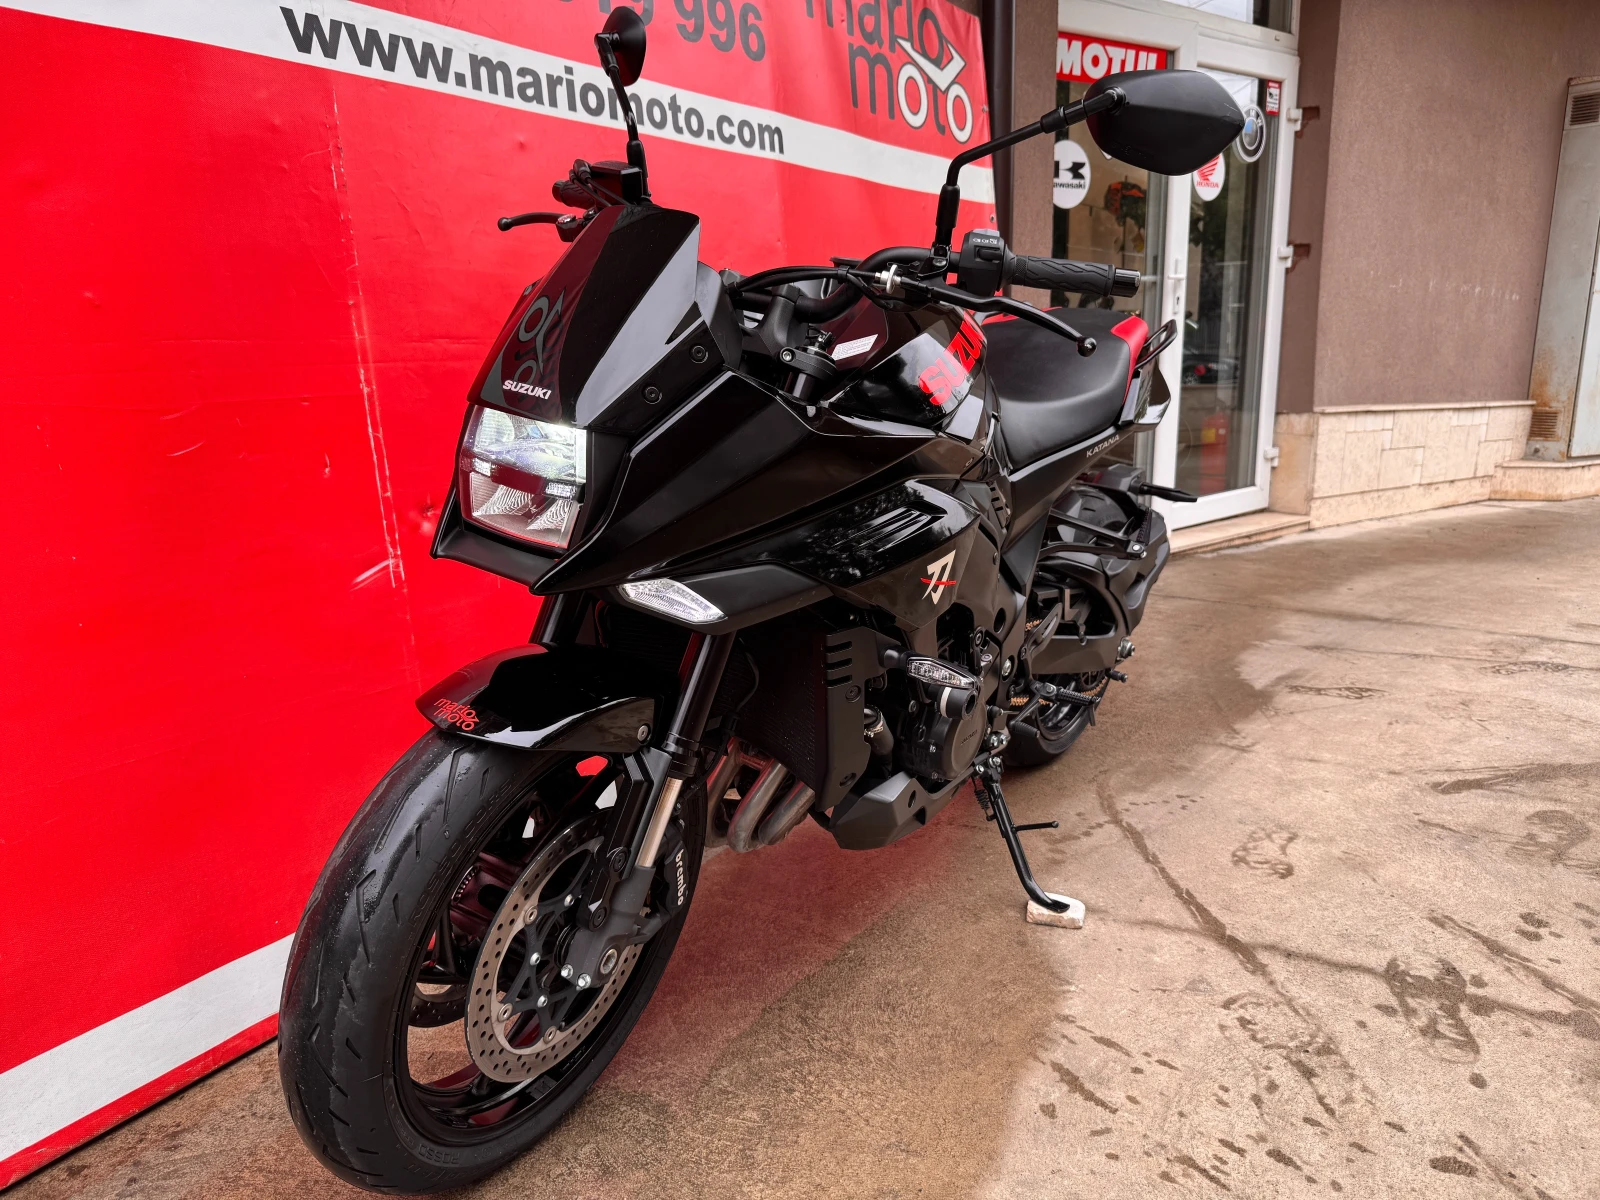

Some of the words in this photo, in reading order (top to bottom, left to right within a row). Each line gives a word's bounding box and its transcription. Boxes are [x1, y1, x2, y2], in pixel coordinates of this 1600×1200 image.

[279, 5, 785, 155] www.mariomoto.com
[848, 42, 973, 144] moto
[1053, 181, 1086, 190] awasaki
[1196, 181, 1220, 189] HONDA
[502, 379, 552, 400] SUZUKI
[1086, 433, 1121, 458] KATANA
[433, 698, 477, 718] mario
[675, 848, 687, 906] brembo
